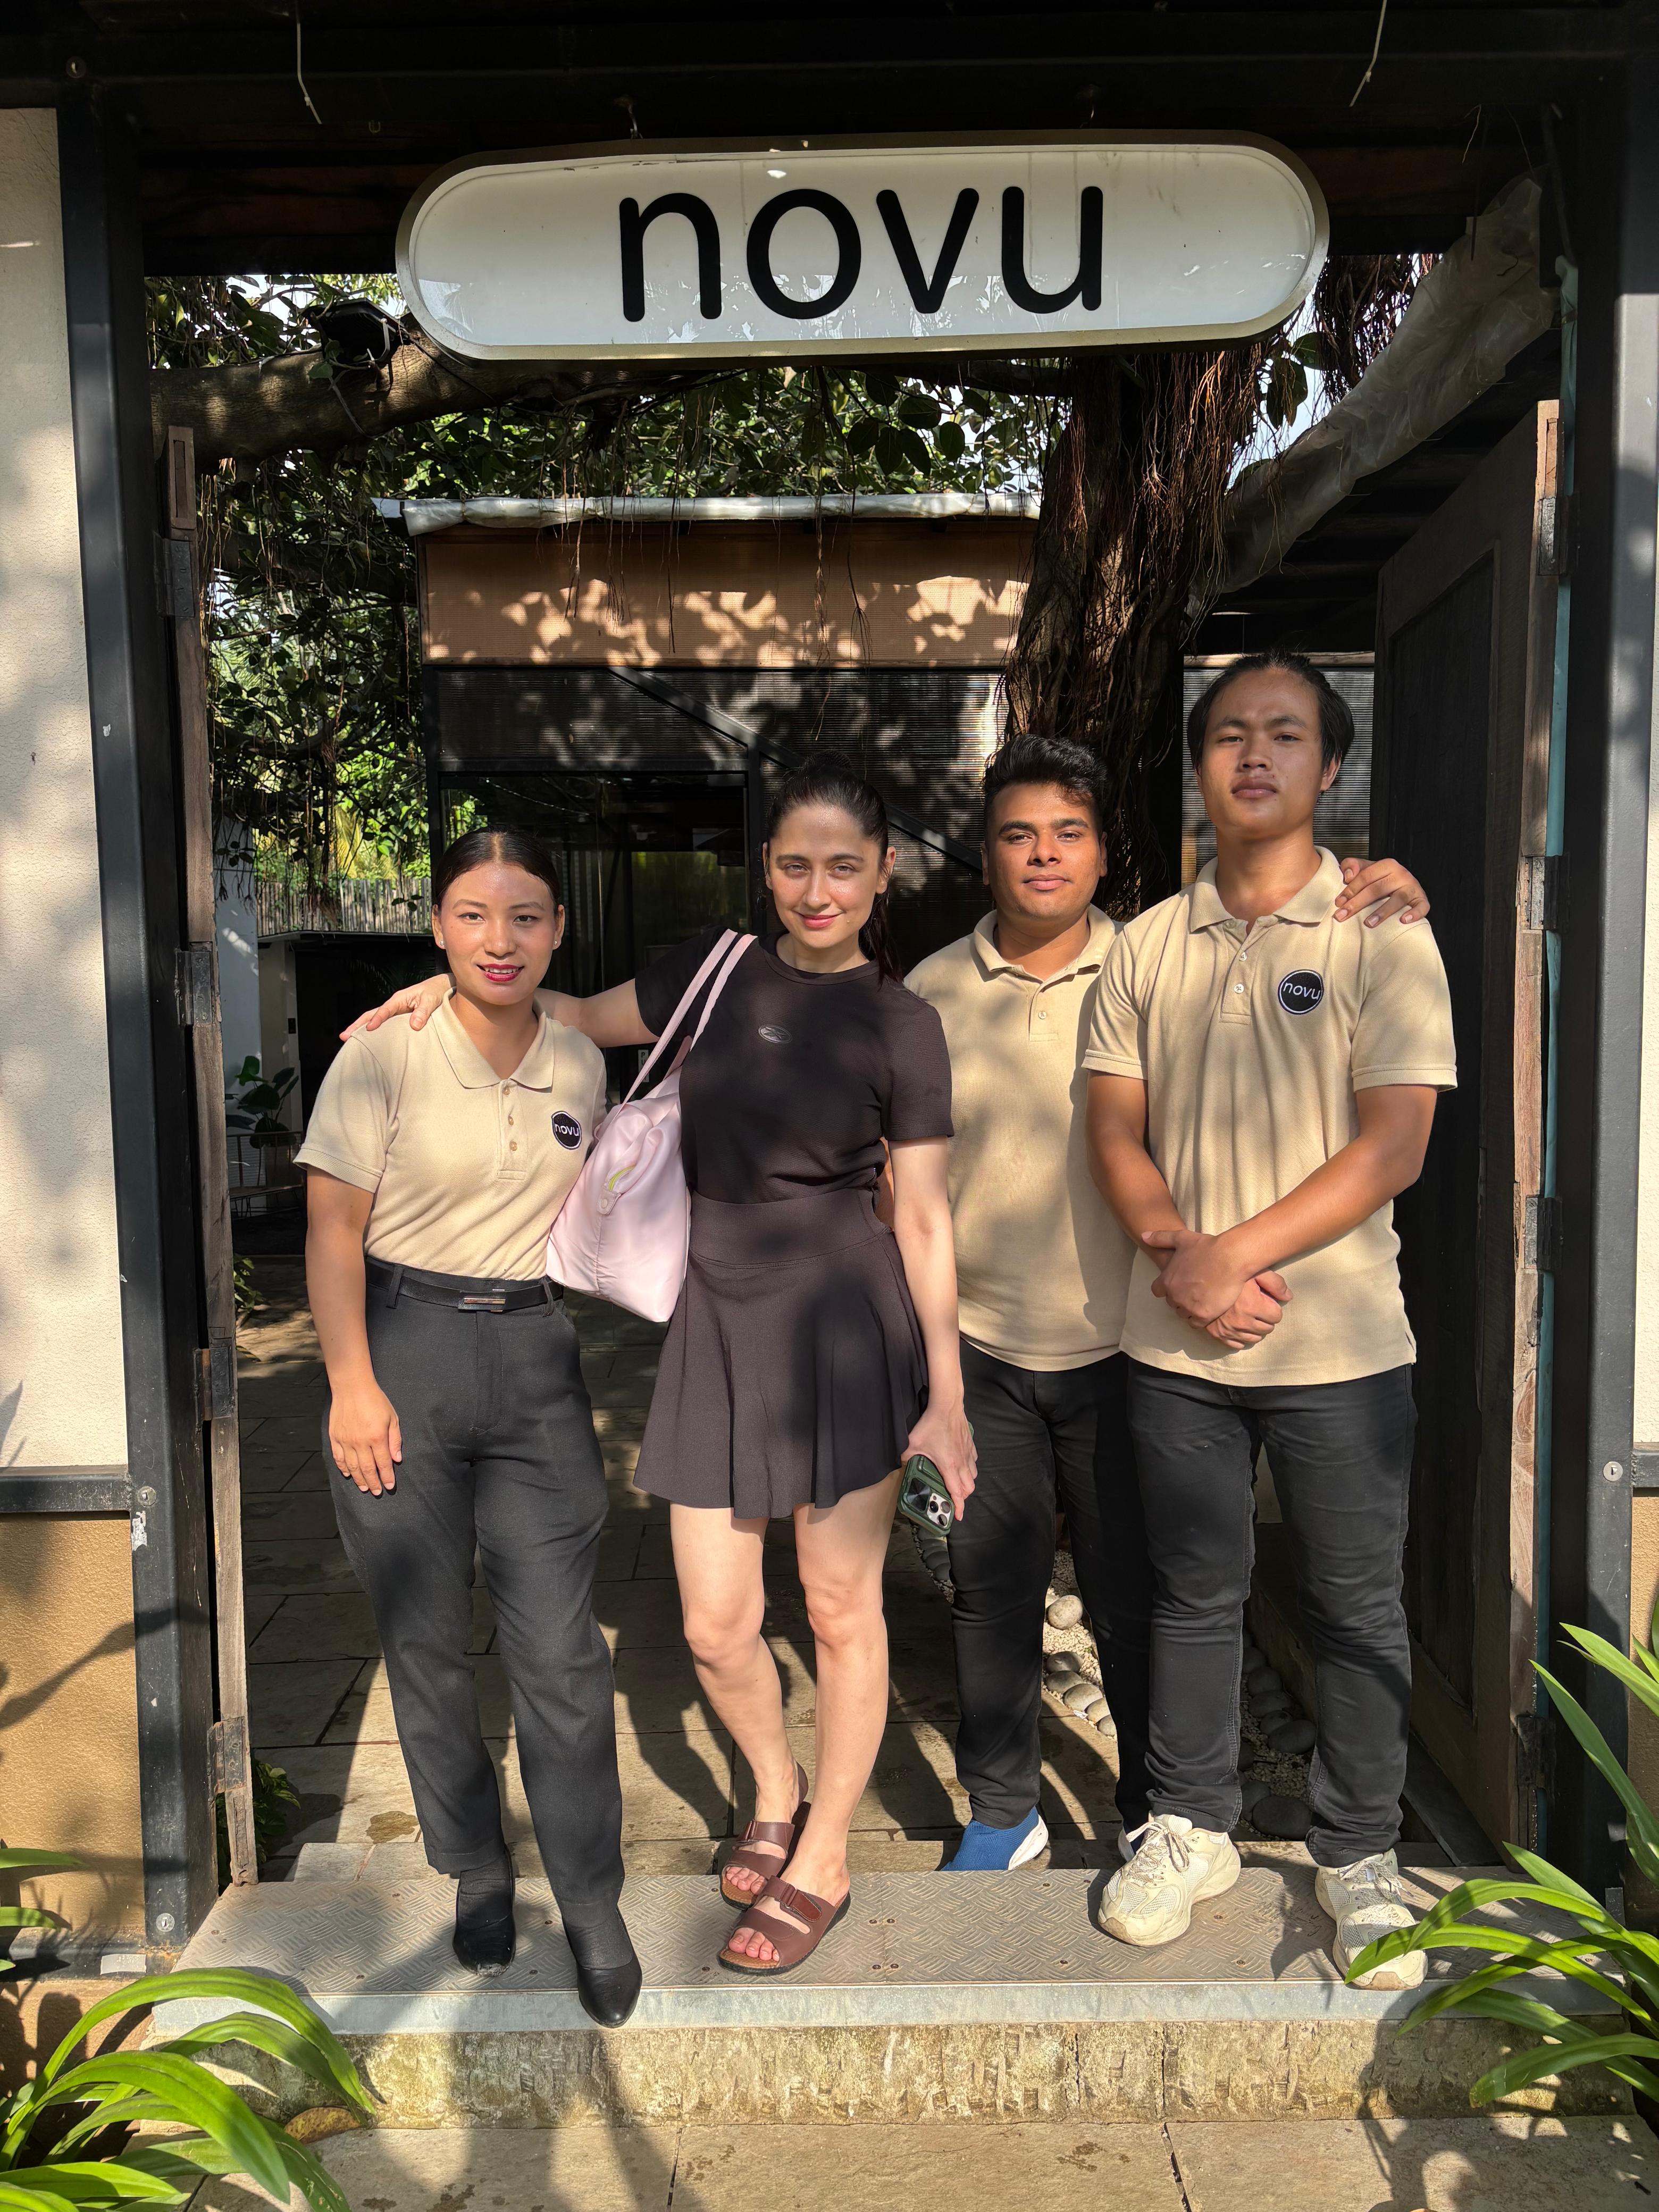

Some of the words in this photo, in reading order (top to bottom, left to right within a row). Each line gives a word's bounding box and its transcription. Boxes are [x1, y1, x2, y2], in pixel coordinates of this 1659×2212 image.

[619, 186, 1103, 322] novu
[1283, 982, 1321, 1000] novu
[555, 1123, 580, 1137] novu
